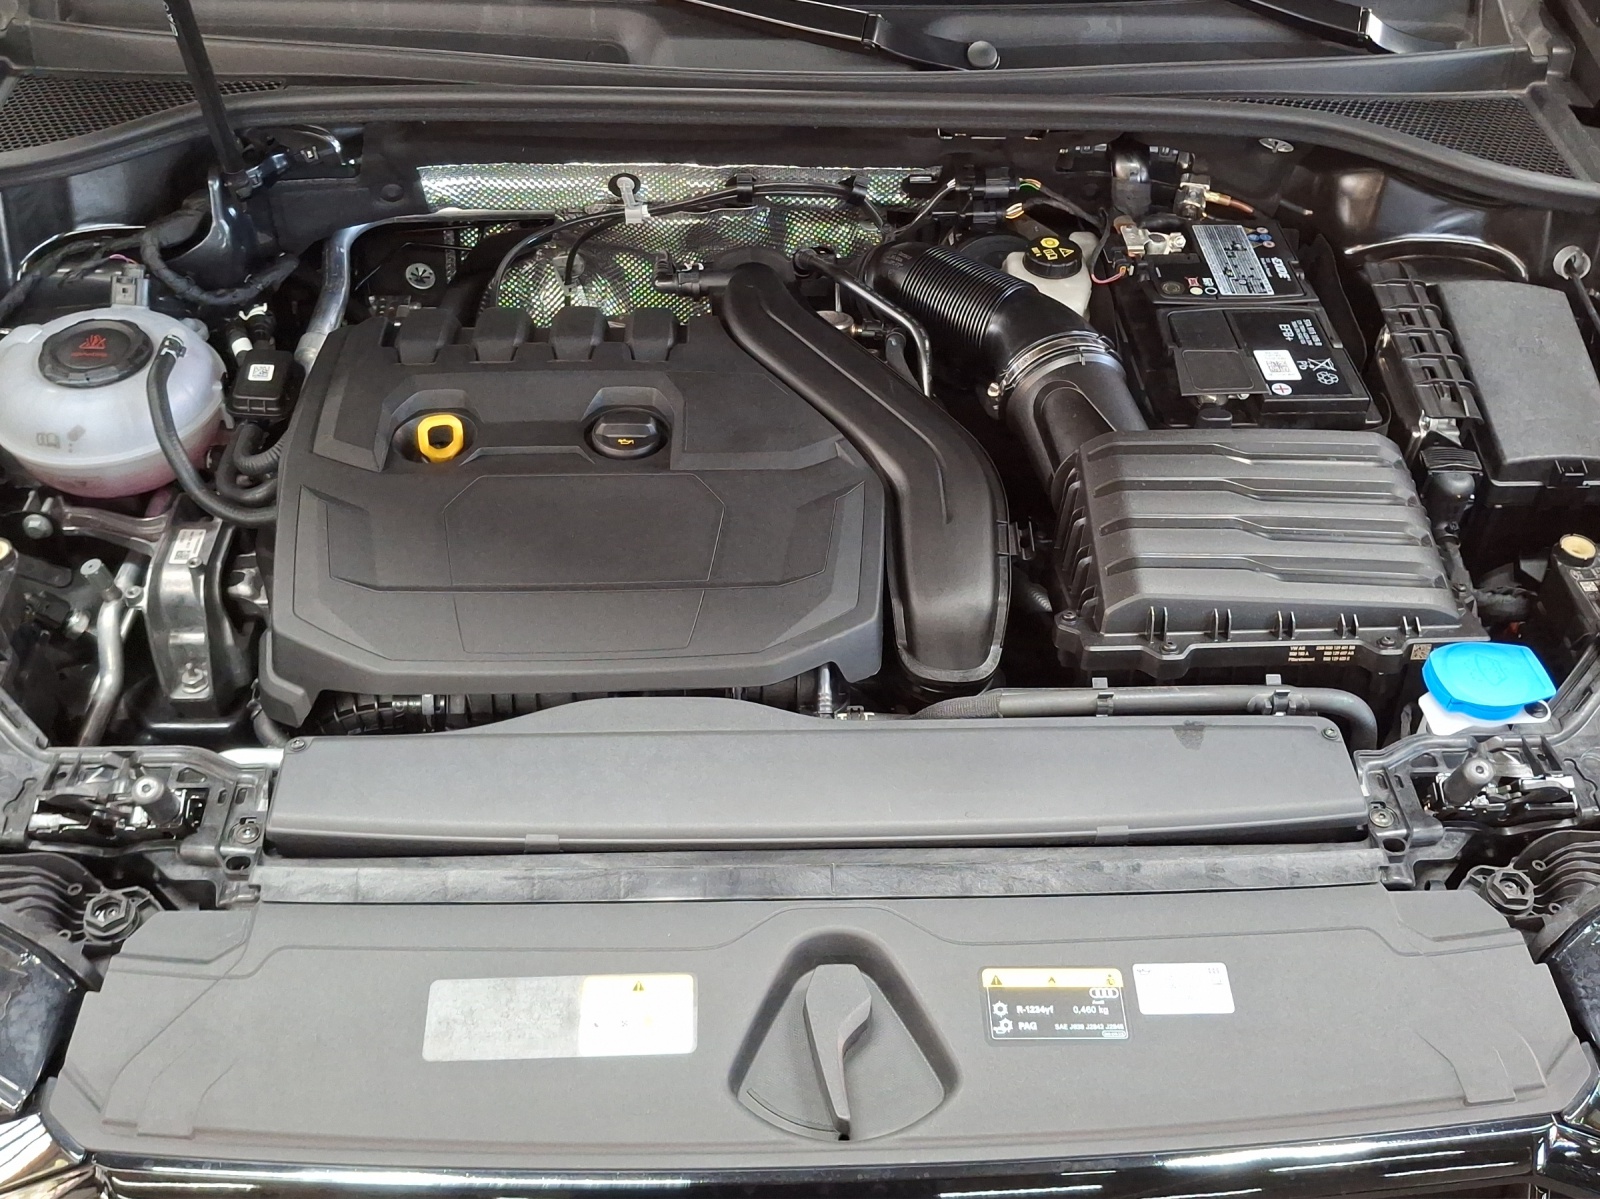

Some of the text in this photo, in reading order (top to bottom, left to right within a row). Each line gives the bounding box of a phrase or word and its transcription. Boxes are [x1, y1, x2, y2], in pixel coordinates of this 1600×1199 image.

[1278, 323, 1295, 341] EFB+
[1296, 360, 1308, 370] Pb
[1016, 1005, 1054, 1015] R-1234yf
[1098, 1005, 1109, 1015] kg
[1018, 1021, 1037, 1030] PAG
